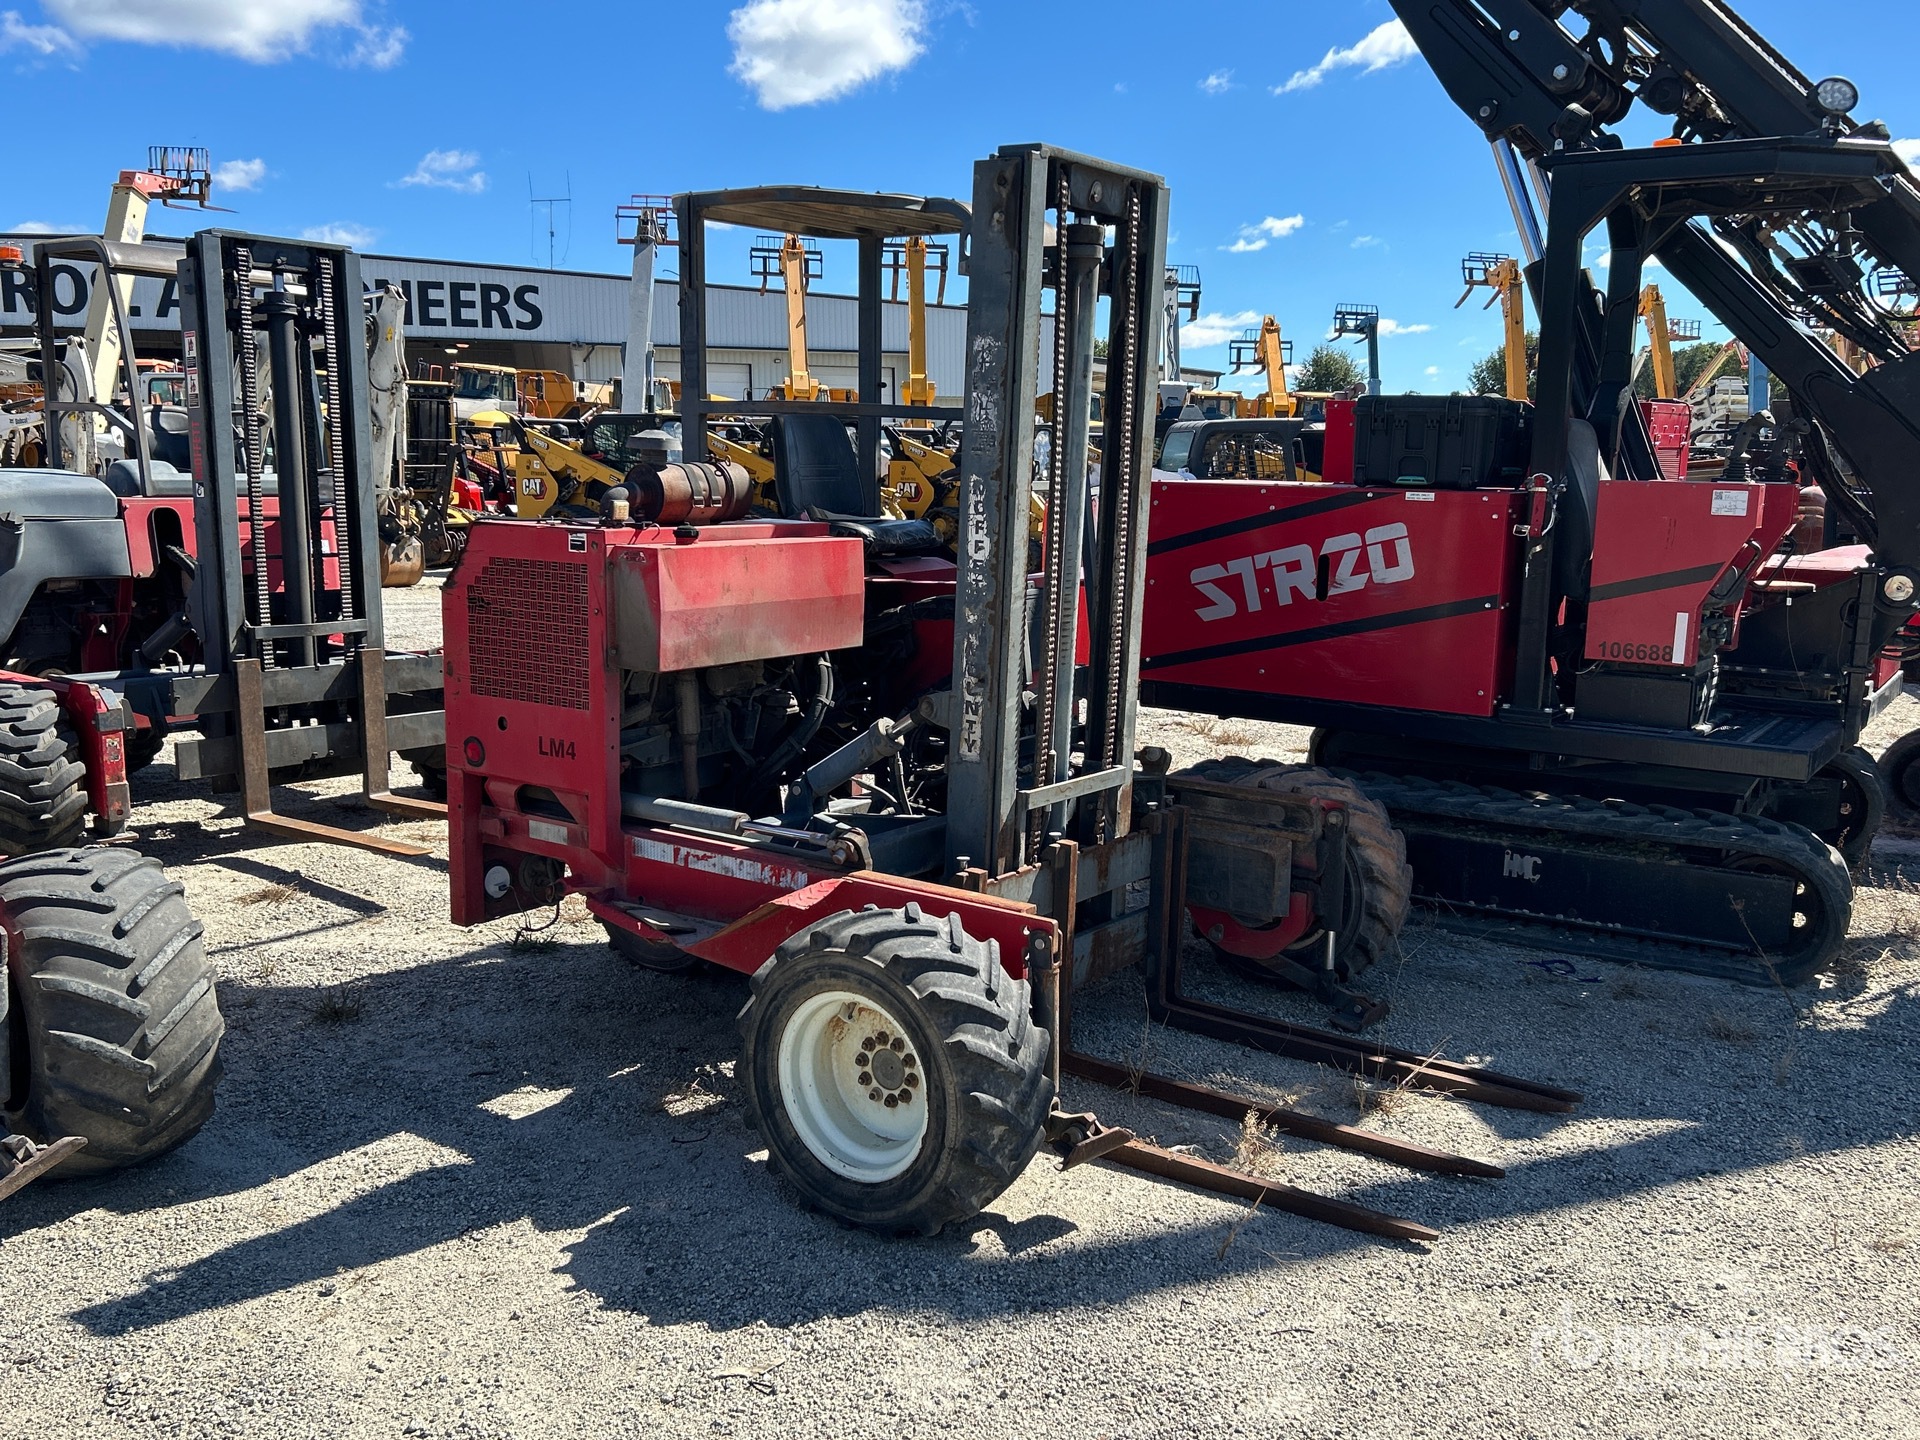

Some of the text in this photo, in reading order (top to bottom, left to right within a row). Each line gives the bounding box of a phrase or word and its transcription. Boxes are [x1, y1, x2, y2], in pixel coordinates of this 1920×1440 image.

[522, 478, 542, 496] CAT
[897, 482, 917, 498] CAT
[1598, 641, 1674, 662] 106688
[538, 735, 577, 761] LM4
[1503, 849, 1542, 883] HMC
